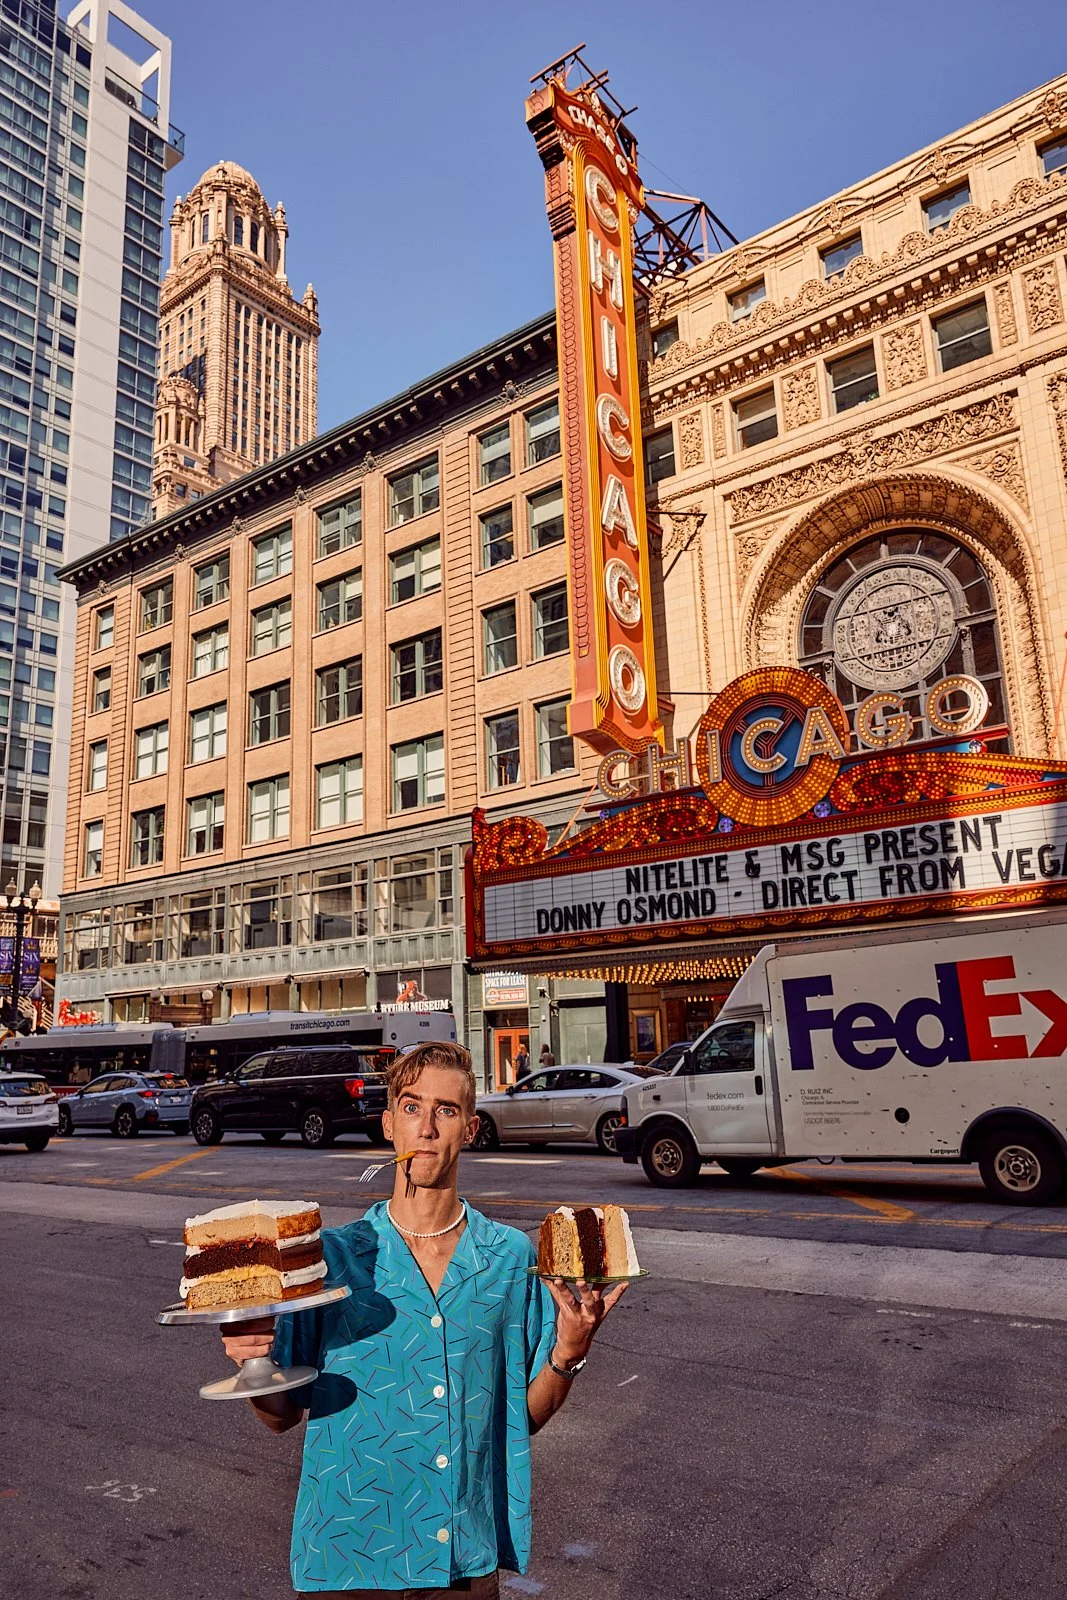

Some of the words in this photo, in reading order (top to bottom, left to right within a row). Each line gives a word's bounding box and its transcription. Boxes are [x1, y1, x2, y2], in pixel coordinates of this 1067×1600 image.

[568, 105, 615, 155] CHASE
[585, 163, 647, 715] CHICAGO
[597, 674, 989, 800] CHICAGO
[625, 854, 729, 895] NITELITE
[745, 850, 761, 878] &
[781, 837, 845, 874] MSG
[864, 814, 1002, 864] PRESENT
[536, 901, 605, 934] DONNY
[617, 888, 716, 925] OSMOND
[762, 869, 858, 910] DIRECT
[879, 856, 966, 897] FROM
[511, 975, 526, 985] LEASE
[290, 1019, 350, 1030] transitchicago.com
[370, 1002, 410, 1013] TRTURE
[411, 999, 449, 1011] MUSEUM
[707, 1092, 744, 1100] fedex.com
